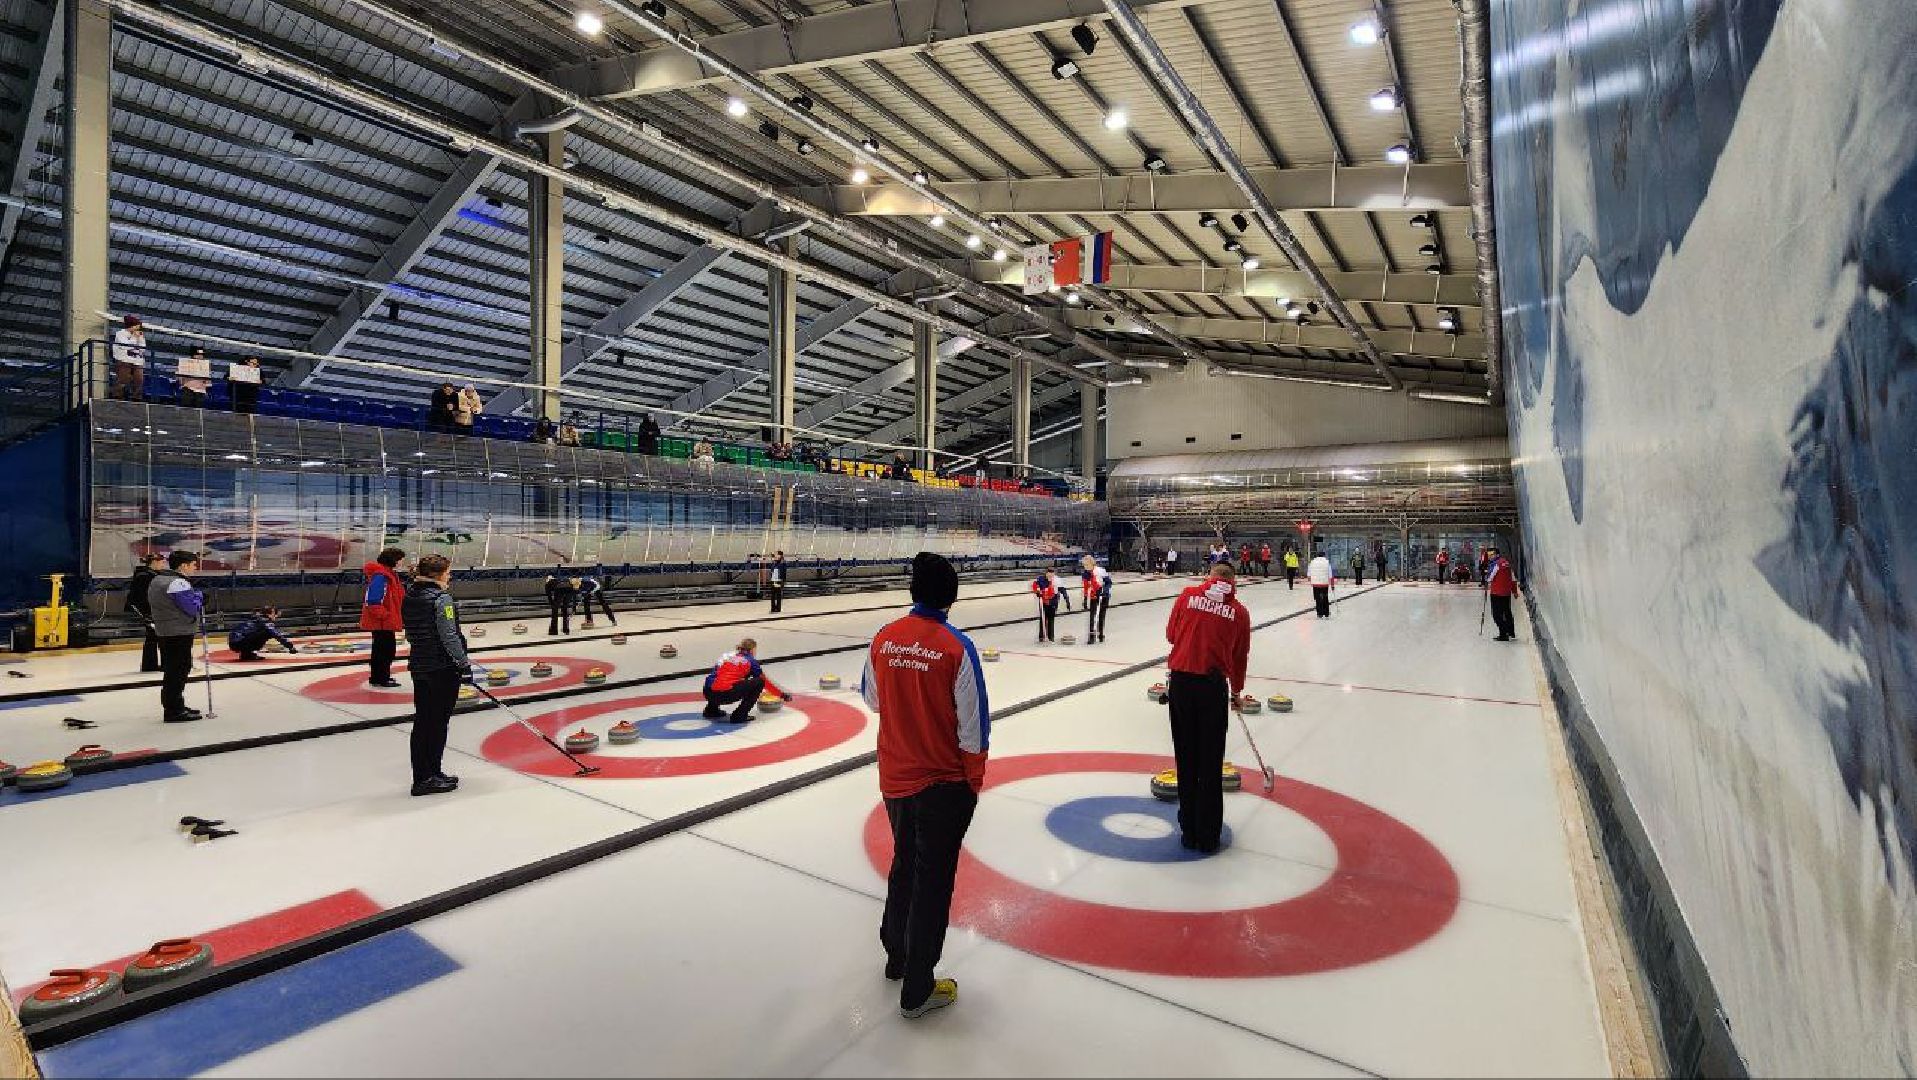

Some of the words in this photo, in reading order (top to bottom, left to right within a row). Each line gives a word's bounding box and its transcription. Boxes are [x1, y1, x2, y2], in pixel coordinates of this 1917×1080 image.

[1187, 595, 1236, 622] МОСКВА
[880, 641, 943, 660] Московская
[888, 656, 929, 672] области
